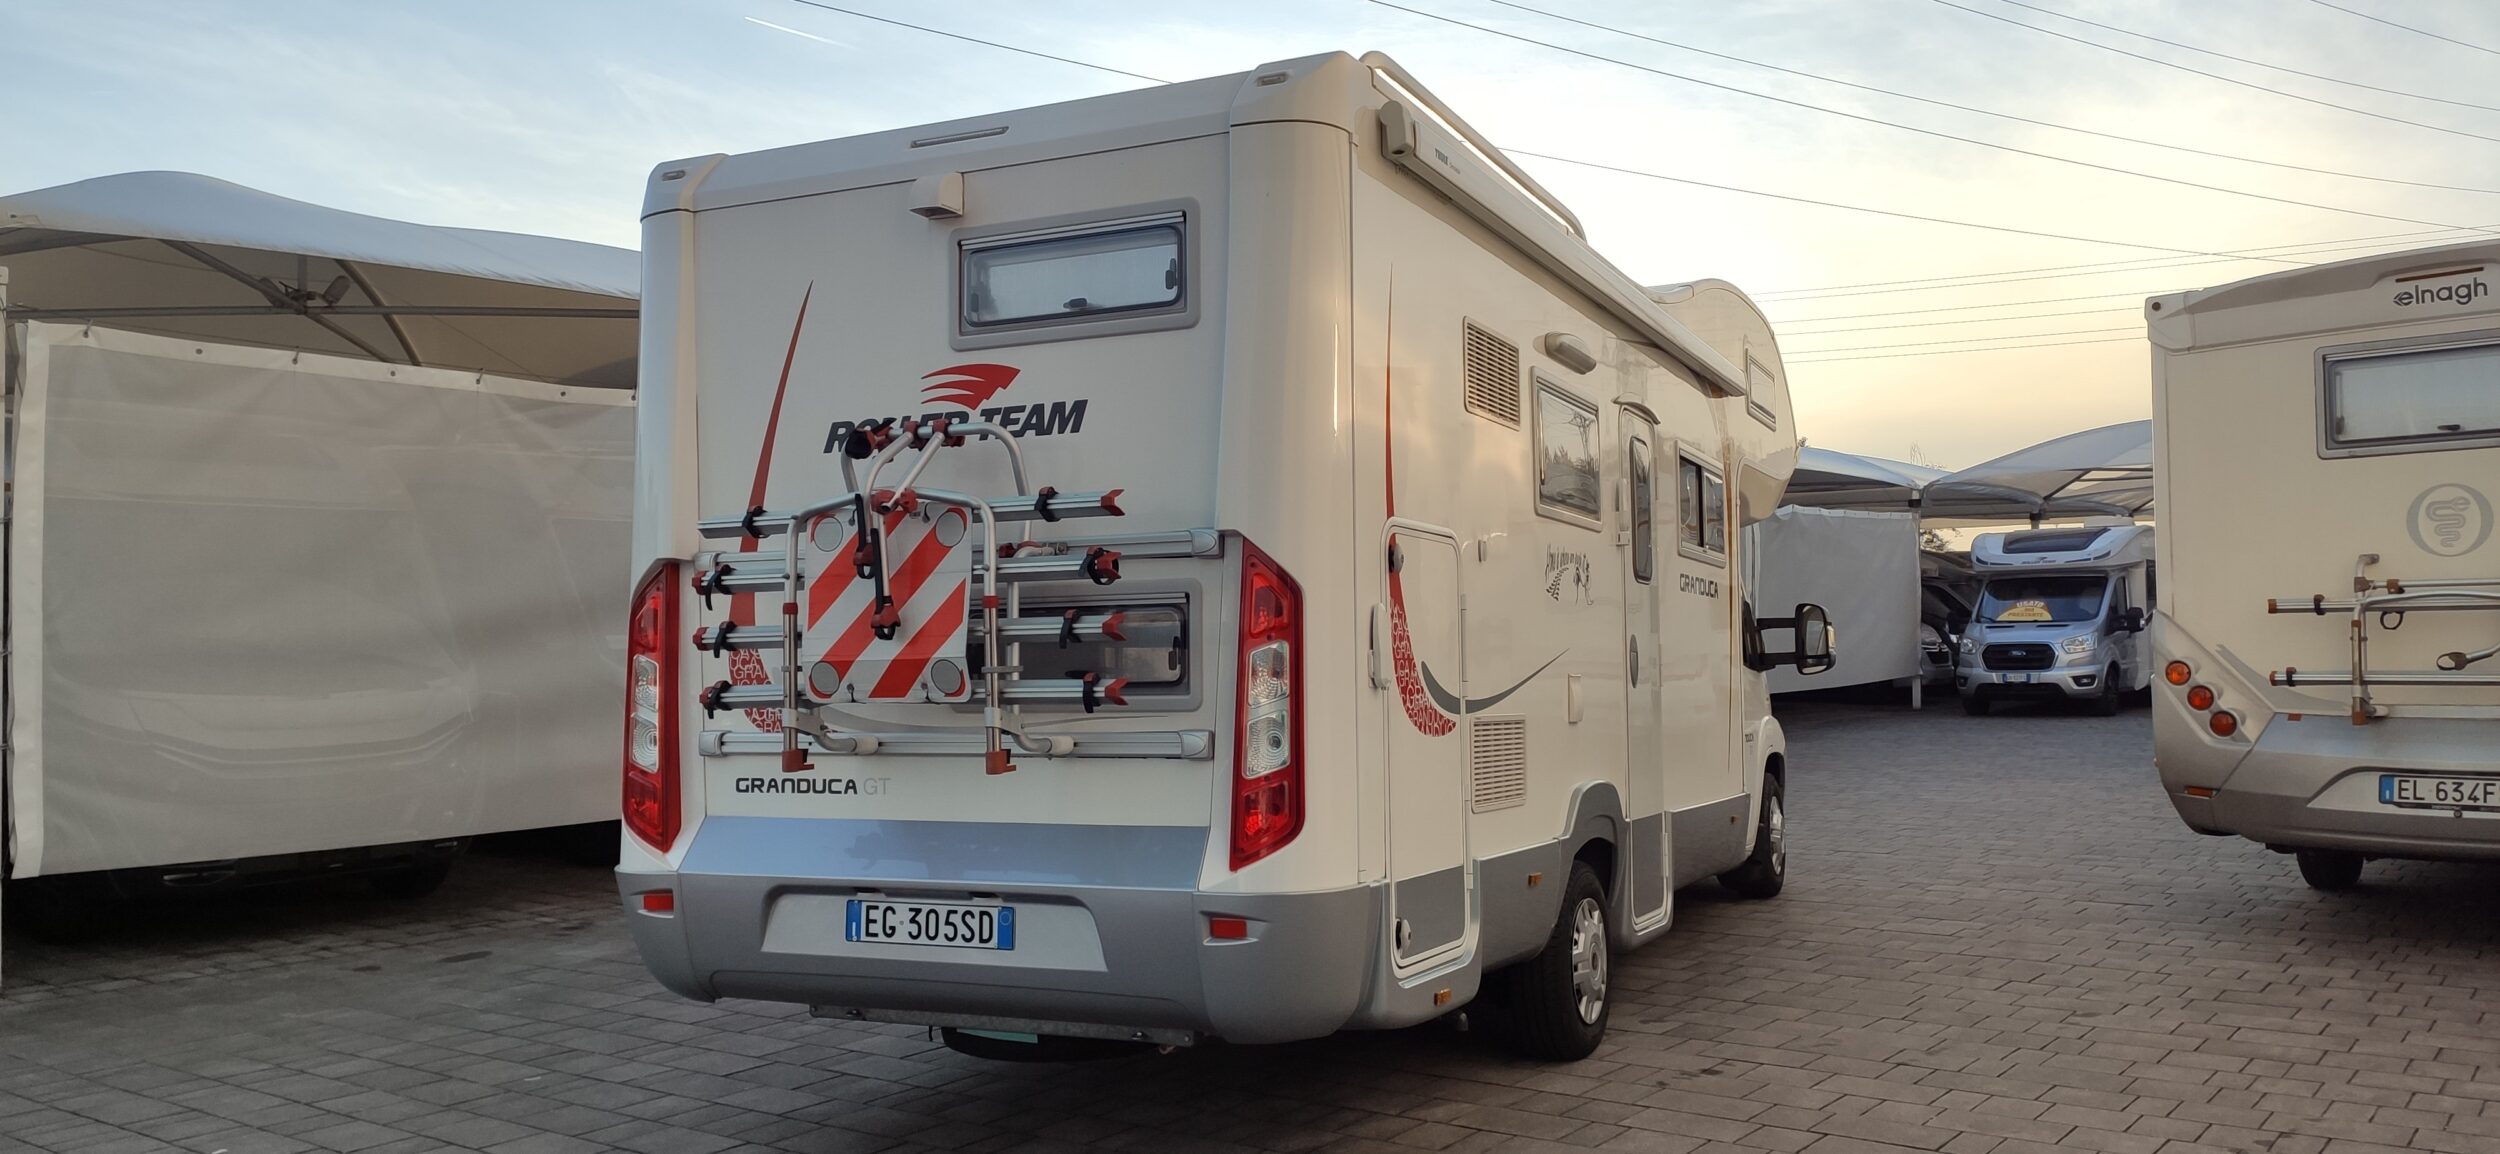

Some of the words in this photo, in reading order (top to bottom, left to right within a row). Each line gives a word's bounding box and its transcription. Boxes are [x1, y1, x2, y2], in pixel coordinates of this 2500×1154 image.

[2392, 277, 2488, 307] elnagh
[823, 410, 970, 454] ROER
[977, 398, 1089, 442] TEAM
[1679, 573, 1719, 599] GRANDUCA
[735, 777, 858, 795] GRANDUCA
[863, 777, 892, 796] GT
[2398, 779, 2426, 801] EL
[2435, 781, 2500, 804] 634F
[865, 905, 897, 938] EG
[907, 907, 994, 944] 305SD
